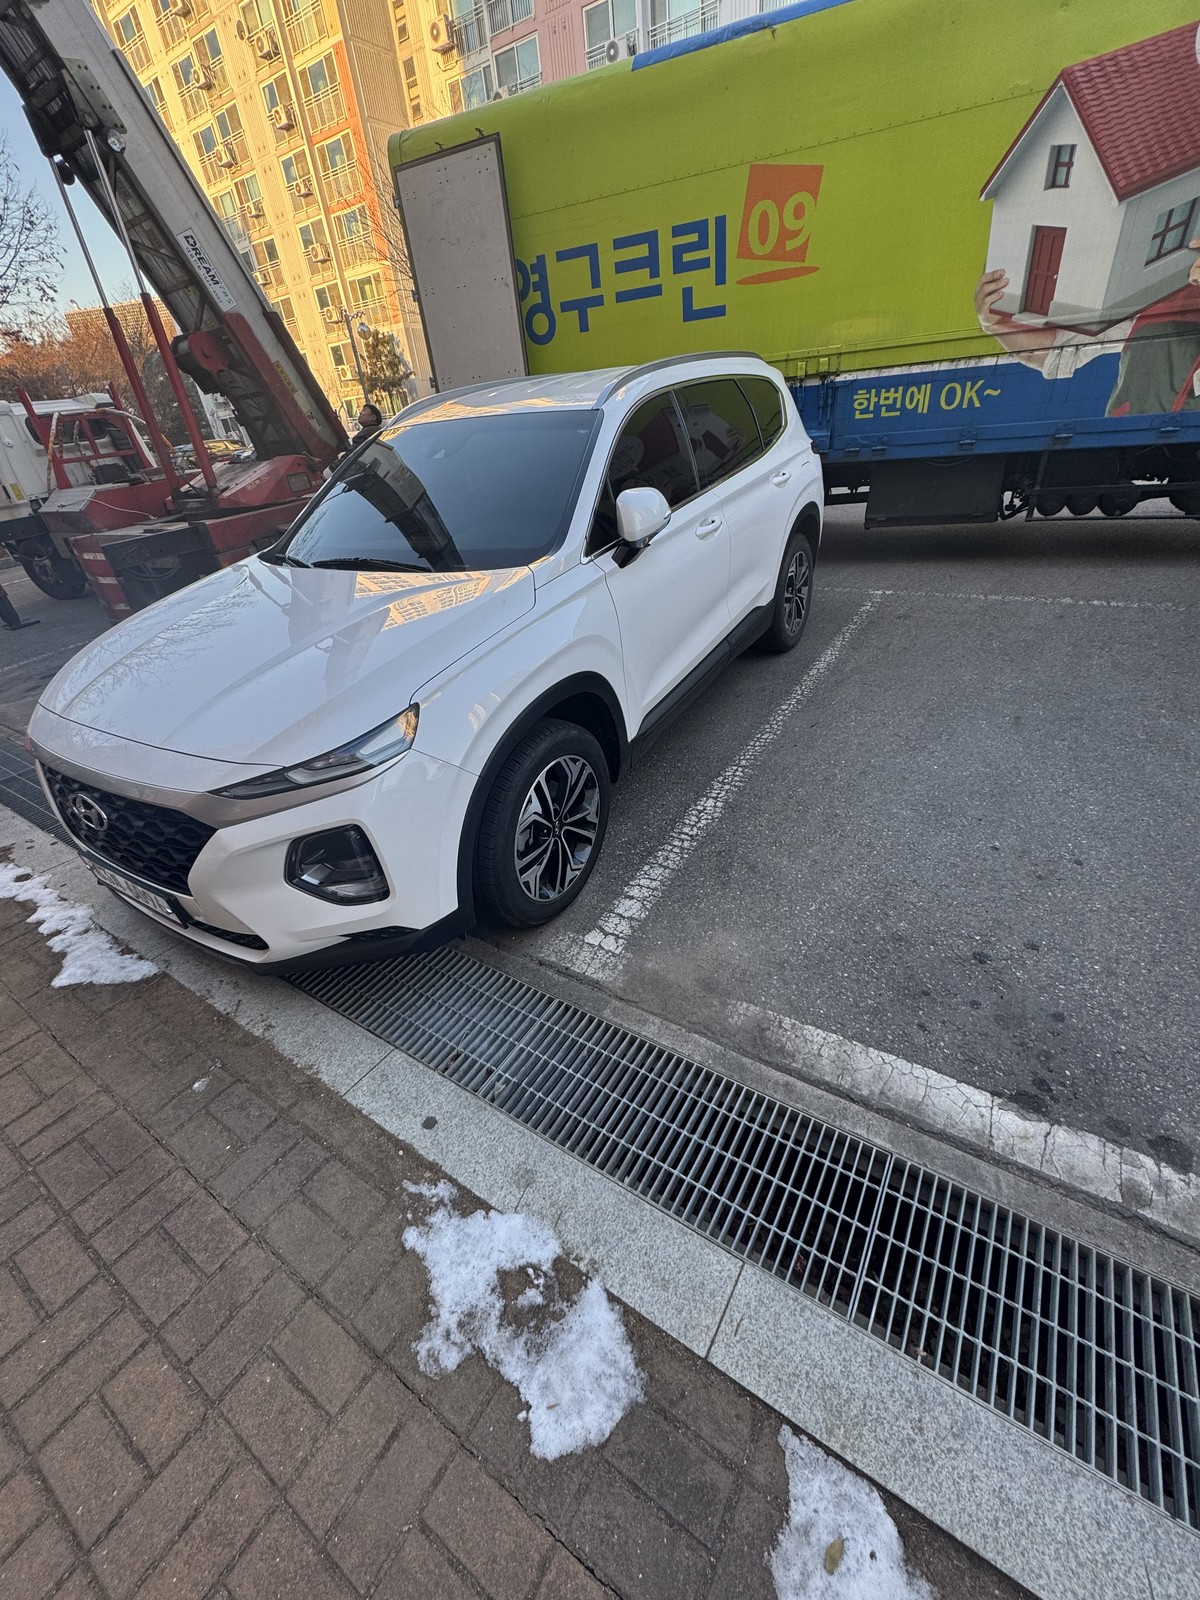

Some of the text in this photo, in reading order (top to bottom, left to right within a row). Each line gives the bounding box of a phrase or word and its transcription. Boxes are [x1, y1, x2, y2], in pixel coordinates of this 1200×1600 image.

[748, 190, 817, 256] 09
[184, 234, 220, 286] DREAM
[516, 214, 727, 346] 영구크린
[853, 379, 1001, 419] 한번에 OK~
